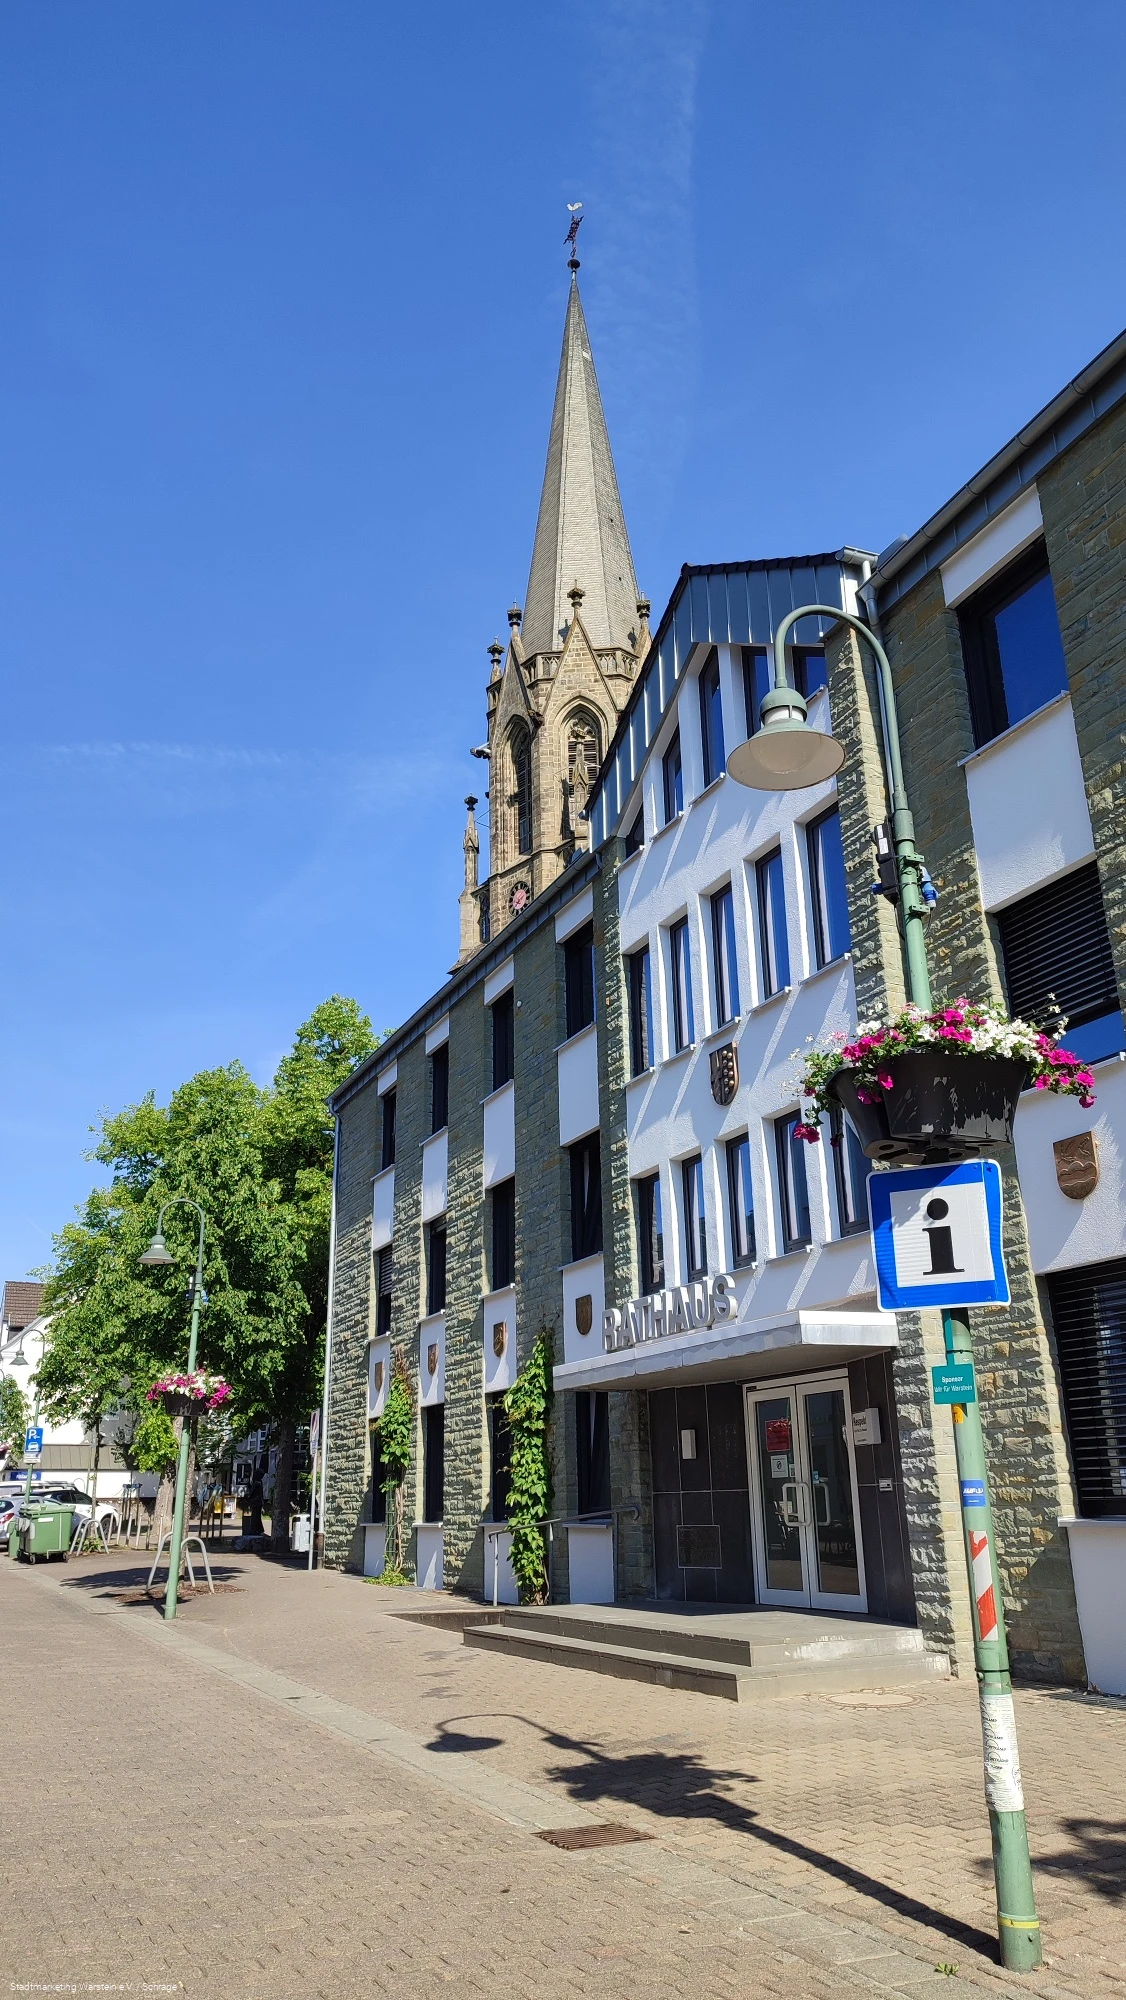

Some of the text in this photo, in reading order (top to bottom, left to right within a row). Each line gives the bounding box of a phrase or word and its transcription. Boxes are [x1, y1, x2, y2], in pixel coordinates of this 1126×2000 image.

[601, 1274, 739, 1351] RATHAUS
[941, 1376, 964, 1385] Sponsor
[951, 1384, 973, 1392] Warstein
[28, 1429, 37, 1440] P
